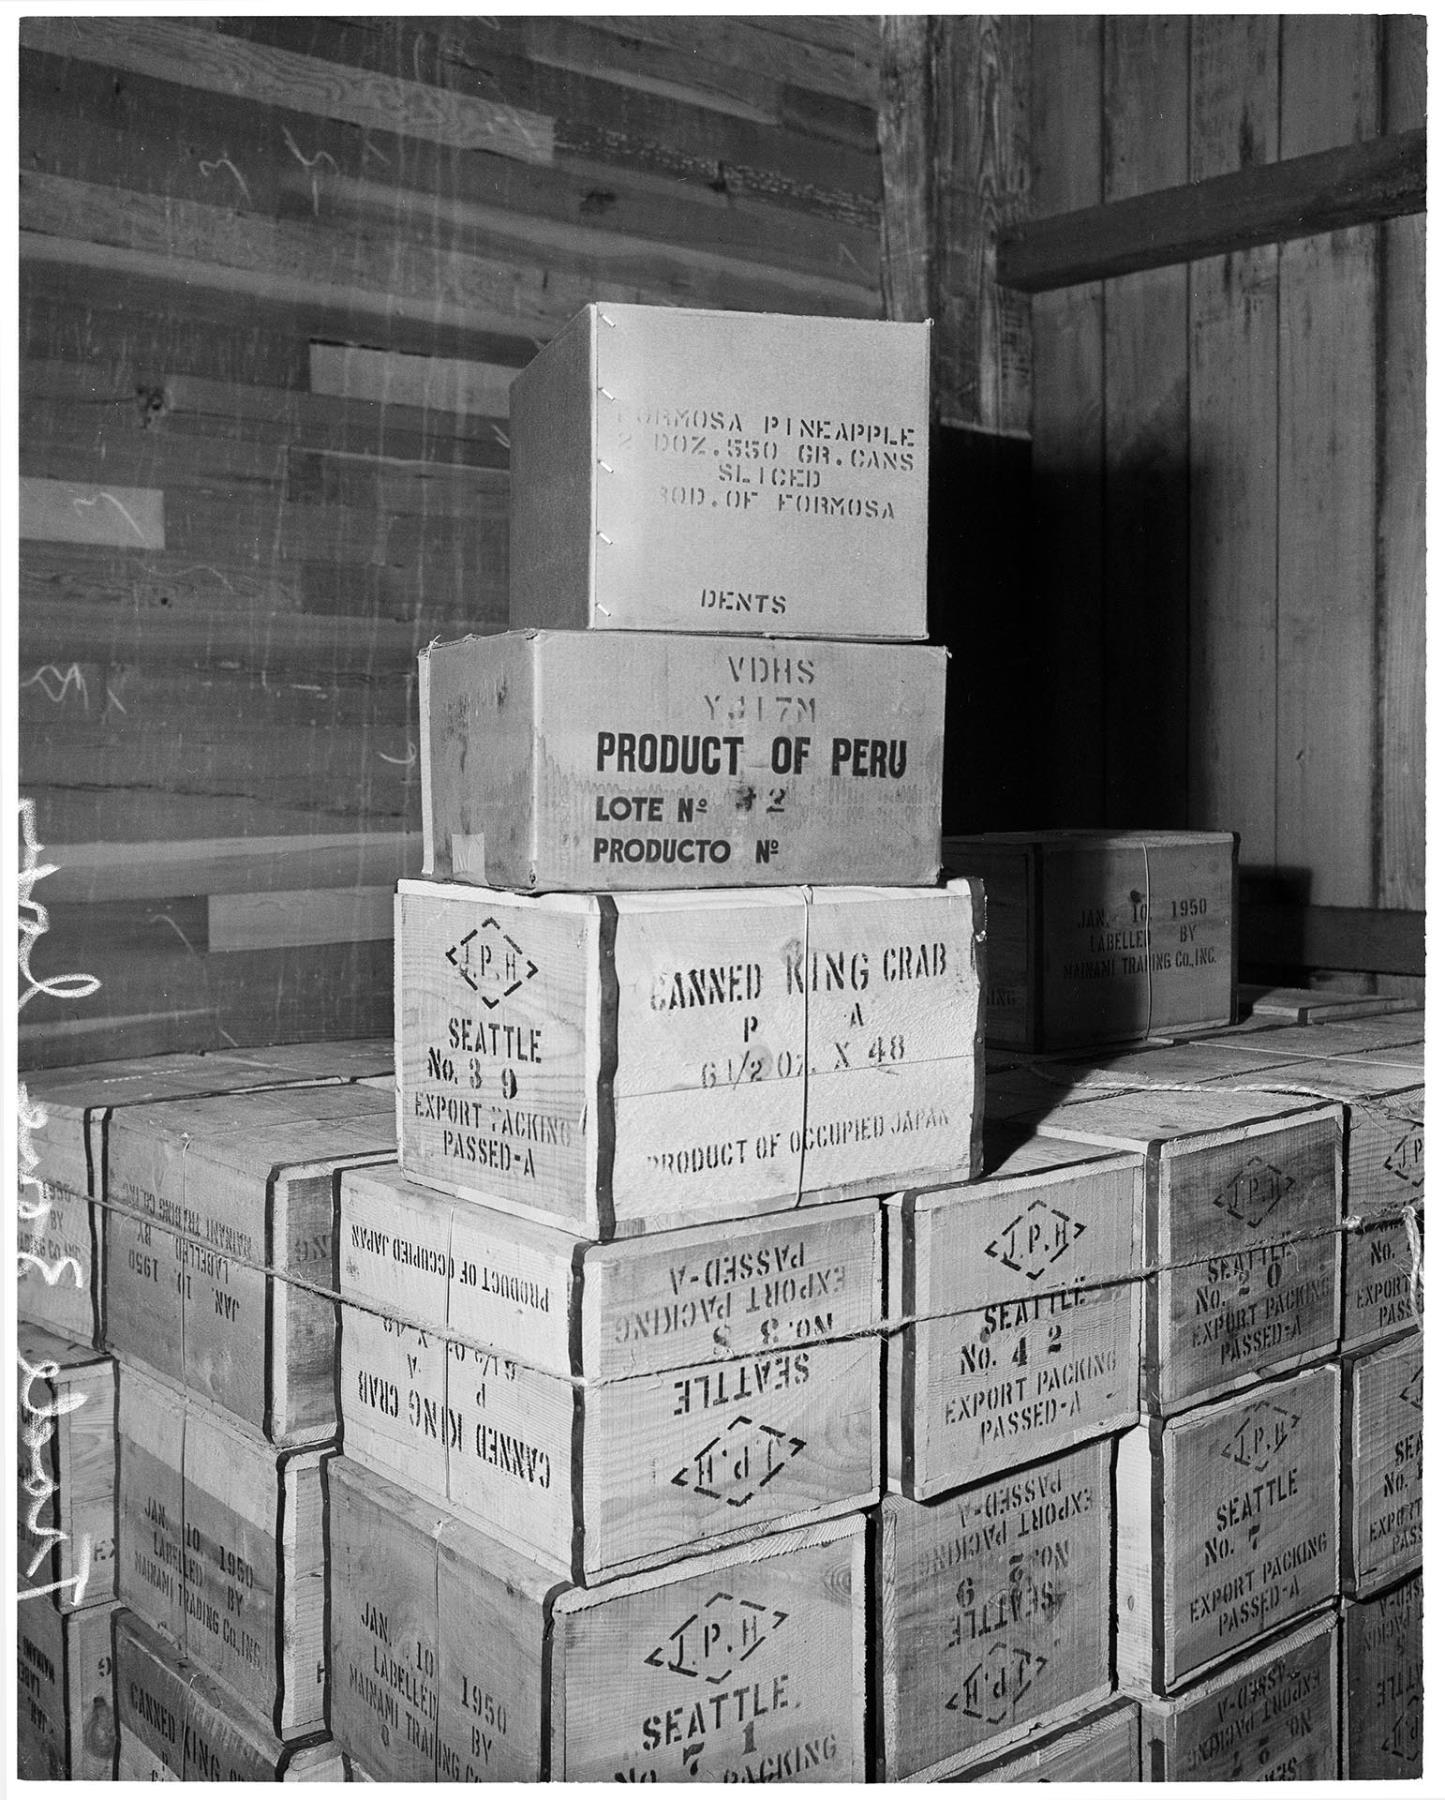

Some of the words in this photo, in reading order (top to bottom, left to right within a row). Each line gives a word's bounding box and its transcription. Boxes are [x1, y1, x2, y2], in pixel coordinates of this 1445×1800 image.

[764, 415, 915, 448] PINEAPPLE
[719, 463, 821, 489] SLICED
[778, 493, 895, 520] FORMOSA
[700, 588, 787, 615] DENTS
[728, 655, 816, 685] VDHS
[596, 731, 744, 776] PRODUCT
[771, 736, 811, 776] OF
[831, 737, 908, 779] PERU
[595, 796, 664, 822] LOTE
[593, 837, 732, 864] PRODUCTO
[1171, 898, 1208, 919] 1950
[1179, 924, 1197, 943] BY
[650, 963, 762, 1011] CANNED
[785, 950, 869, 995] KING
[883, 942, 947, 983] CRAB
[448, 1017, 542, 1064] SEATTLE
[743, 1015, 758, 1043] P
[868, 1033, 905, 1063] 48
[415, 1091, 482, 1129] EXPORT
[443, 1129, 536, 1179] PASSED-A
[756, 1132, 781, 1160] OF
[789, 1115, 885, 1154] OCCUPIED
[350, 1223, 389, 1257] JAPAN
[392, 1233, 455, 1280] OCCUPIED
[127, 1248, 159, 1283] 1950
[459, 1260, 478, 1287] OF
[481, 1265, 549, 1313] PRODUCT
[669, 1241, 805, 1296] PASSED-A
[746, 1265, 846, 1314] EXPORT
[614, 1291, 732, 1344] PACKING
[1192, 1305, 1257, 1349] EXPORT
[1265, 1276, 1331, 1320] PACKING
[1220, 1314, 1302, 1366] PASSED-A
[358, 1370, 399, 1419] CRAB
[673, 1352, 810, 1416] SEATTLE
[944, 1376, 1028, 1426] EXPORT
[1037, 1351, 1118, 1395] PACKING
[408, 1389, 463, 1453] KING
[980, 1389, 1082, 1446] PASSED-A
[476, 1423, 551, 1489] CANNED
[957, 1469, 1063, 1528] PASSED-A
[1017, 1487, 1093, 1538] EXPORT
[1215, 1467, 1299, 1533] SEATTLE
[1247, 1522, 1261, 1552] 7
[219, 1545, 254, 1590] 1950
[1190, 1568, 1257, 1624] EXPORT
[1262, 1531, 1328, 1585] PACKING
[177, 1583, 219, 1635] TRADING
[227, 1585, 244, 1618] BY
[948, 1580, 1056, 1649] SEATTLE
[1217, 1574, 1302, 1638] PASSED-A
[130, 1681, 176, 1745] CANNED
[373, 1644, 438, 1722] LABELLED
[471, 1725, 493, 1766] BY
[461, 1675, 507, 1736] 1950
